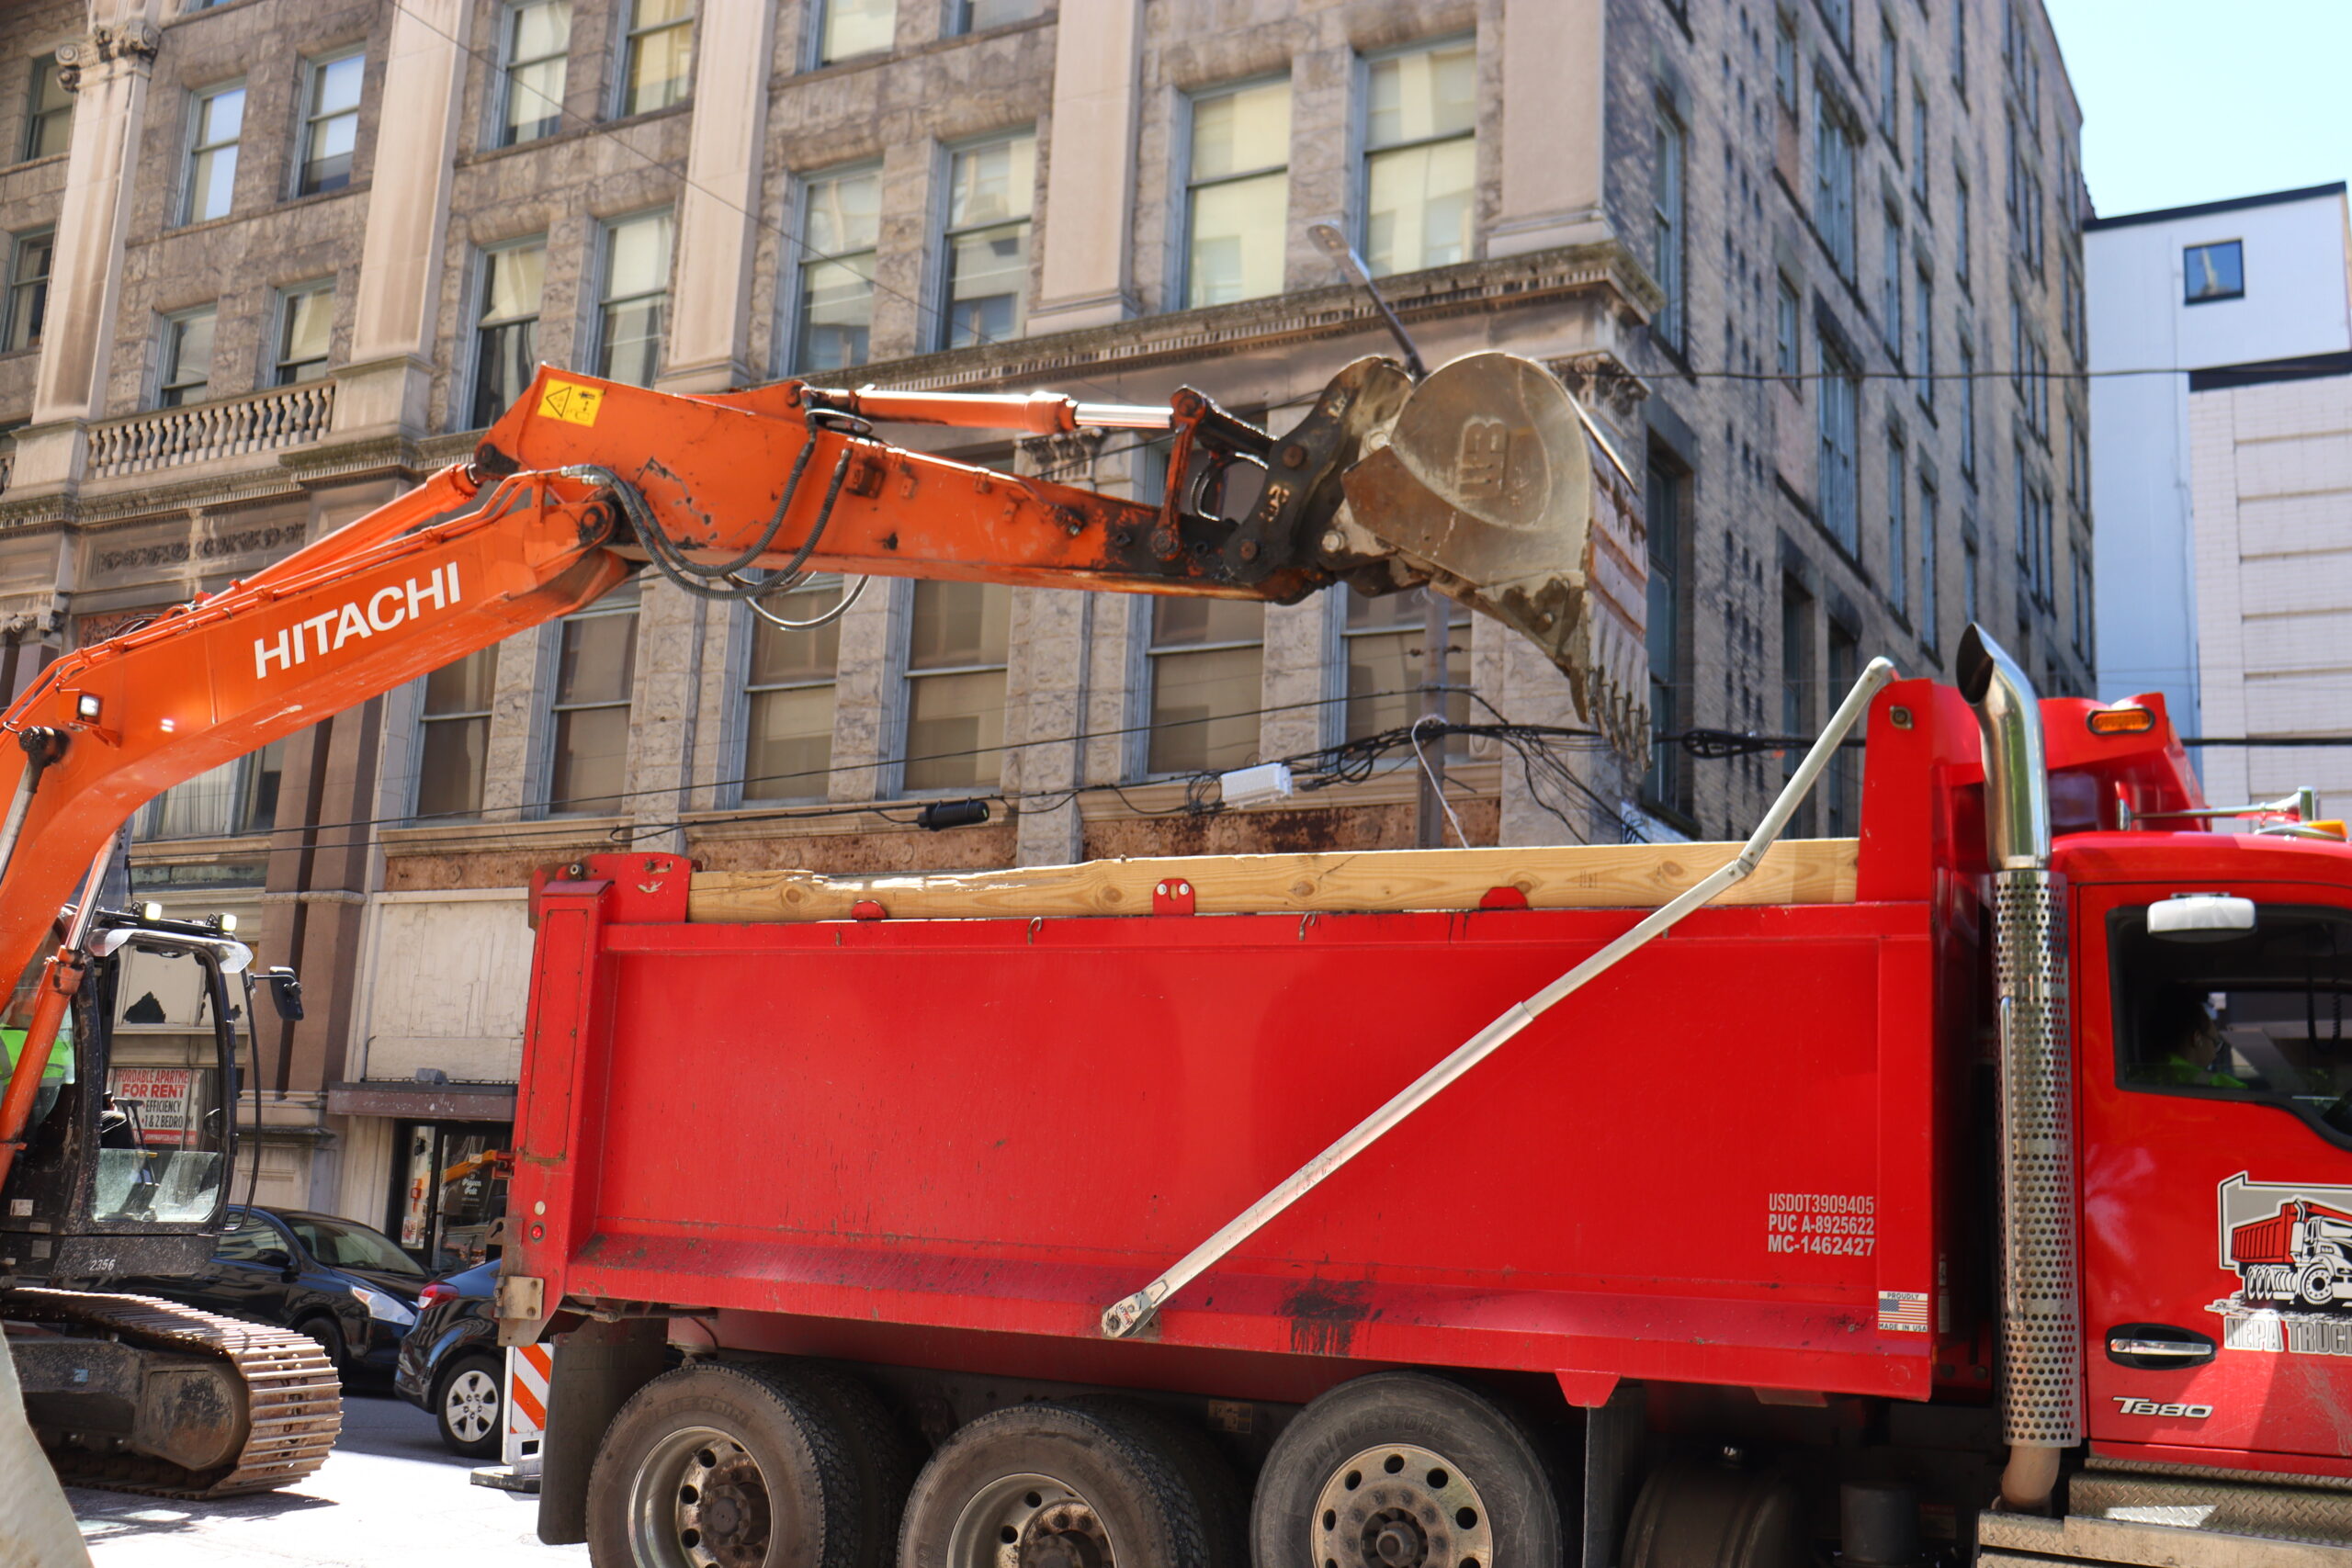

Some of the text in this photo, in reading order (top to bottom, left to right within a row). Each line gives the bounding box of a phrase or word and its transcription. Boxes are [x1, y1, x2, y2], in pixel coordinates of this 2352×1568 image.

[254, 561, 461, 680] HITACHI
[121, 1084, 187, 1099] FOR RENT
[145, 1100, 182, 1112] EFFICIENCY
[144, 1115, 195, 1129] 1 & 2 BEDROM
[1769, 1193, 1874, 1214] USDOT3909405
[1768, 1213, 1874, 1235] PUC A-8925622
[1768, 1234, 1875, 1257] MC-1462427
[89, 1258, 116, 1271] 2356
[1886, 1292, 1919, 1301] PROUDLY
[1879, 1323, 1899, 1331] MADE
[2226, 1317, 2282, 1350] NEPA
[2112, 1396, 2213, 1418] T880
